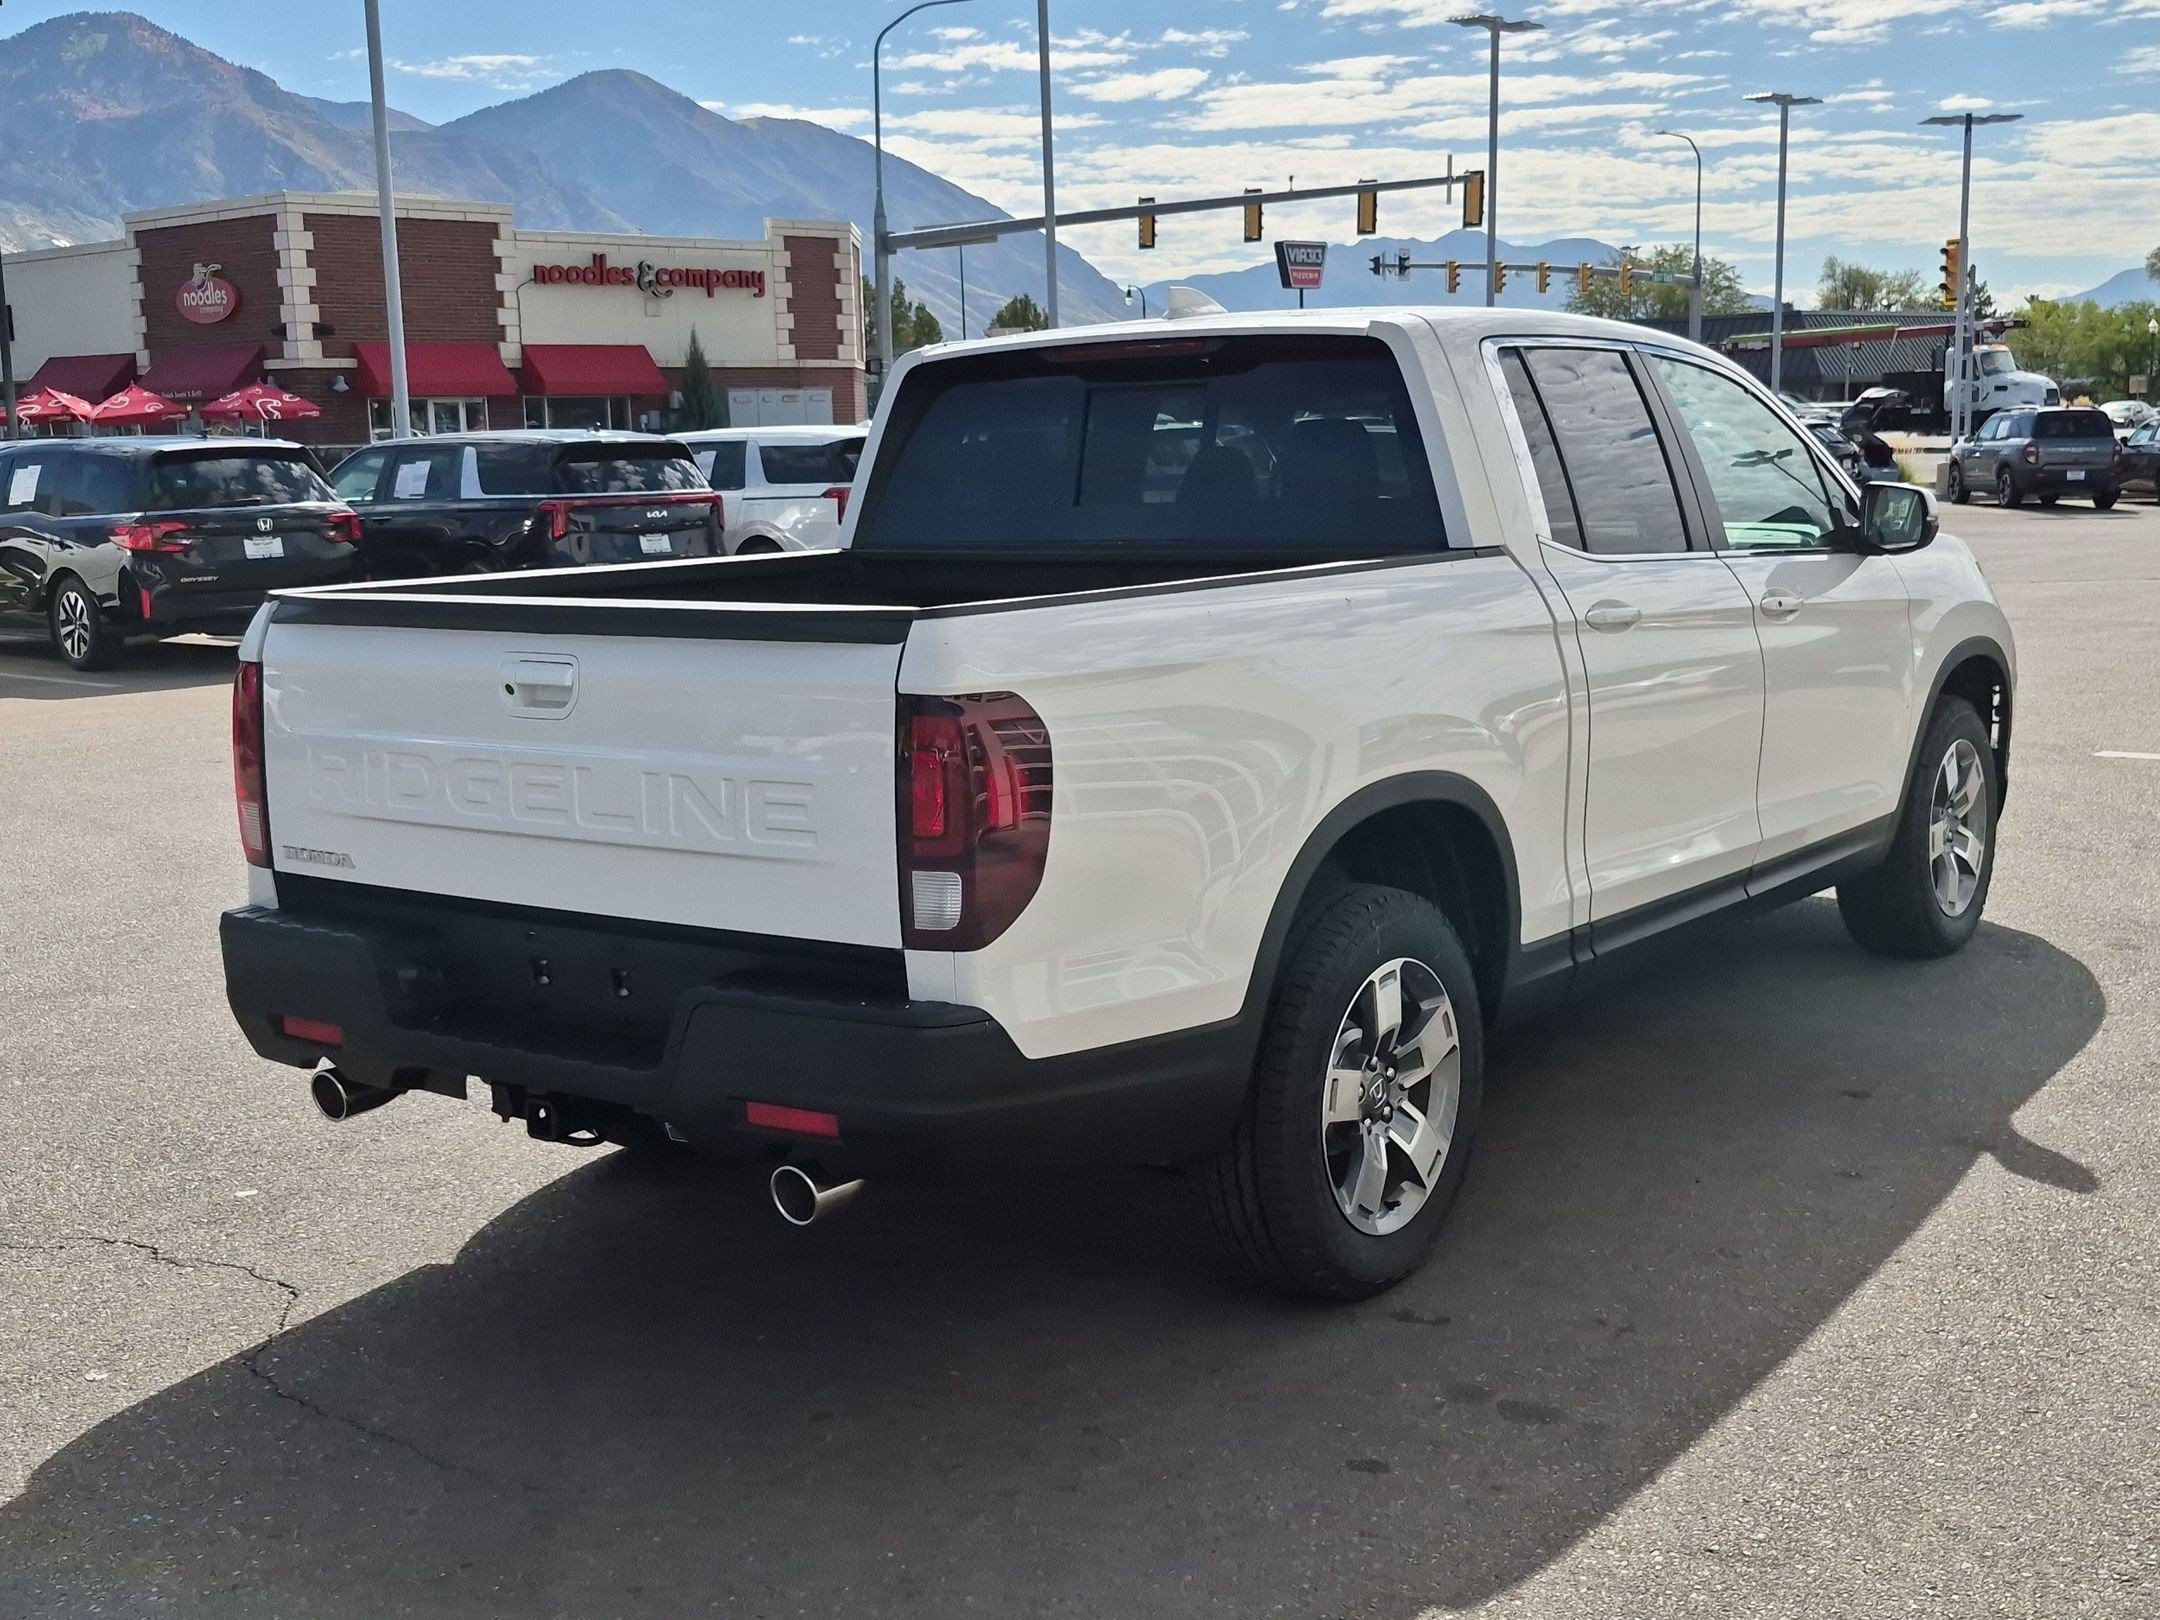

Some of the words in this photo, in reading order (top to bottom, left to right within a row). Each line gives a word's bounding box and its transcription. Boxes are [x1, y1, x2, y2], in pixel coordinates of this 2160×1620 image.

[533, 253, 635, 286] noodles
[637, 260, 674, 298] &
[656, 267, 765, 298] company
[183, 280, 228, 307] noodles
[180, 575, 219, 583] ODYSSEY
[306, 744, 818, 849] RIDGELINE
[282, 844, 356, 870] HONDA
